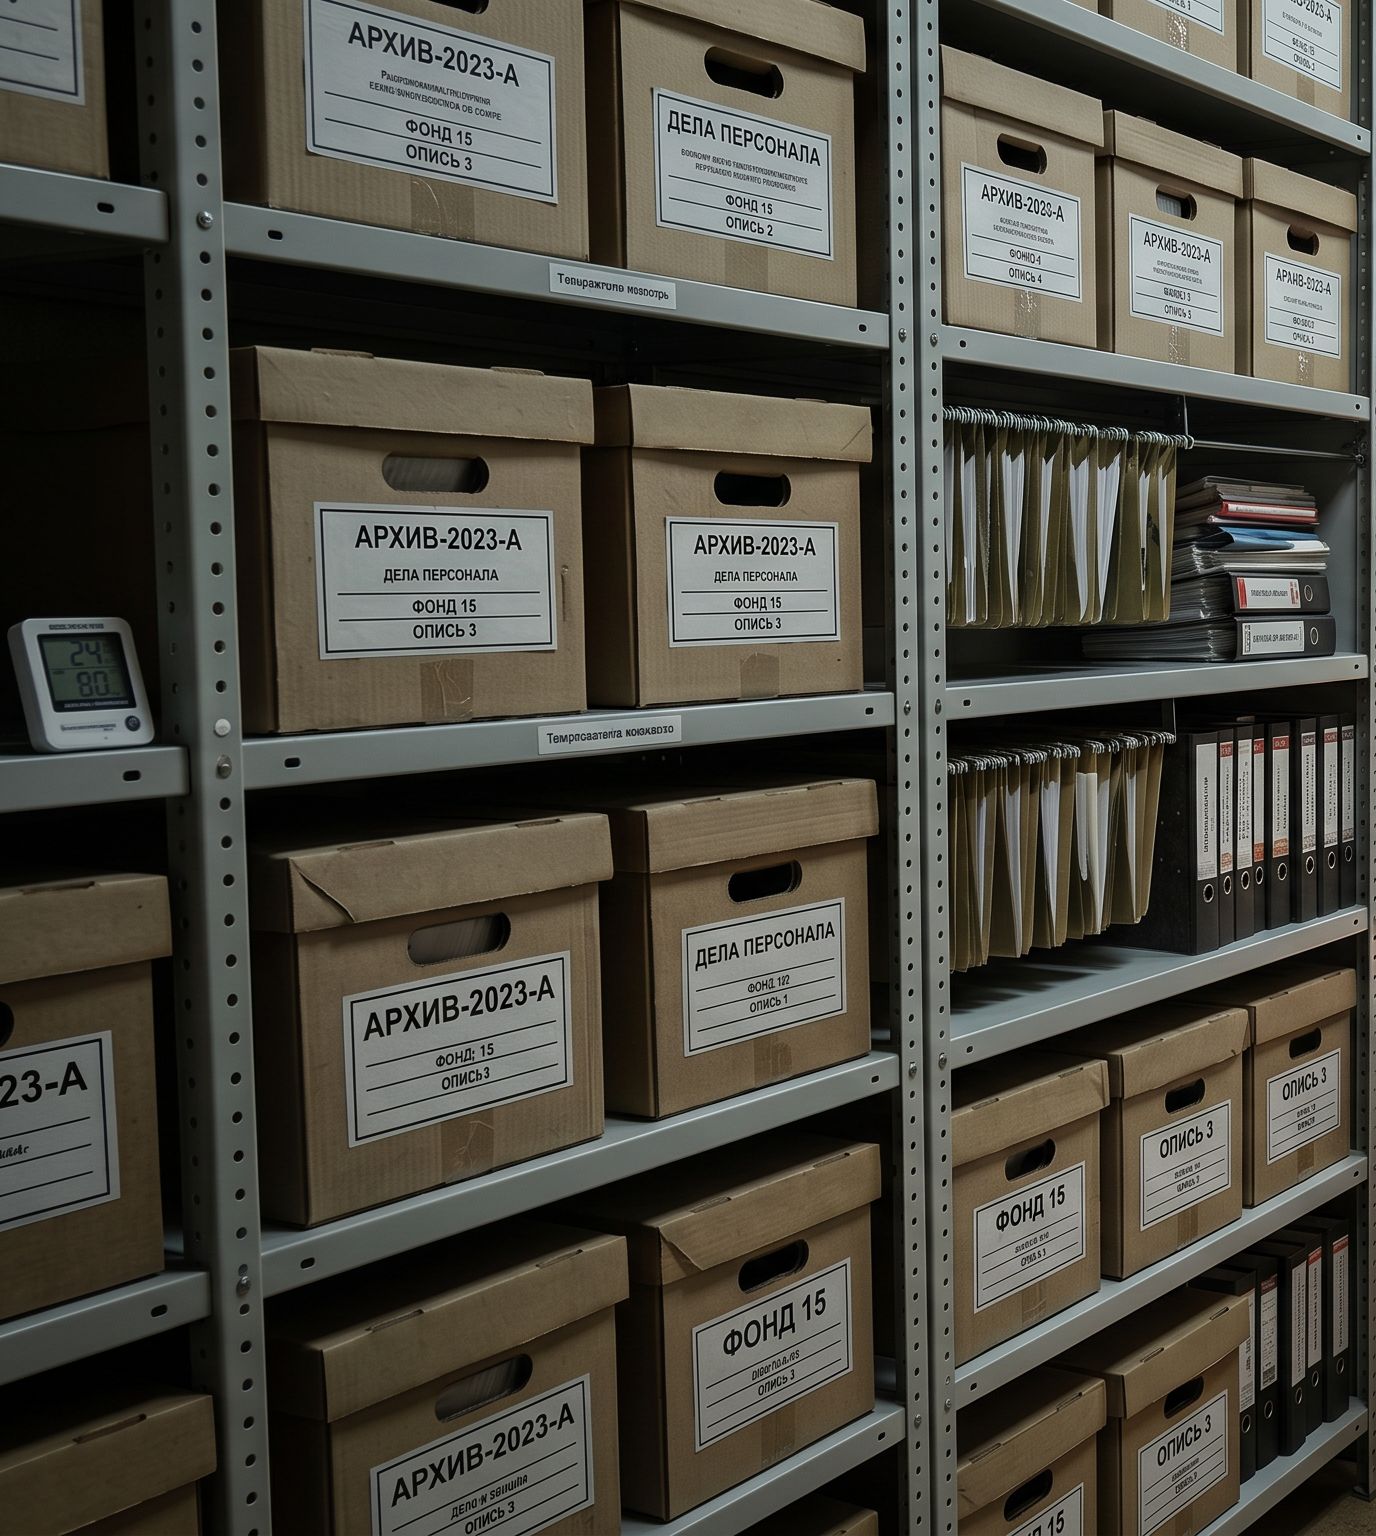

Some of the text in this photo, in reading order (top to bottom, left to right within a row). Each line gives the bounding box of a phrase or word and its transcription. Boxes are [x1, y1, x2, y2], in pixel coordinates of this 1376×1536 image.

[348, 21, 519, 87] АРХИВ-2023-А
[405, 119, 473, 146] ФОНД 15
[667, 110, 821, 167] ДЕЛА ПЕРСОНАЛА
[405, 144, 473, 171] ОПИСЬ 3
[725, 194, 758, 213] ФОНД
[725, 216, 774, 237] ОПИСЬ 2
[355, 525, 522, 550] АРХИВ-2023-А
[693, 534, 816, 556] АРХИВ-2023-А
[383, 569, 499, 583] ДЕЛА ПЕРСОНАЛА
[412, 599, 477, 615] ФОНД 15
[733, 596, 782, 611] ФОНД 15
[412, 623, 477, 639] ОПИСЬ 3
[734, 617, 782, 631] ОПИСЬ 3
[70, 640, 103, 667] 24
[77, 671, 110, 698] 80
[695, 921, 835, 972] ДЕЛА ПЕРСОНАЛА
[362, 975, 556, 1042] АРХИВ-2023-А
[749, 994, 789, 1013] ОПИСЬ 1
[480, 1043, 494, 1057] 15
[1282, 1066, 1327, 1101] ОПИСЬ 3
[1159, 1120, 1213, 1159] ОПИСЬ 3
[995, 1183, 1066, 1233] ФОНД 15
[722, 1287, 827, 1357] ФОНД 15
[790, 1369, 796, 1381] 3
[1156, 1414, 1212, 1467] ОПИСЬ 3
[390, 1402, 575, 1508] АРХИВ-2023-А
[464, 1501, 515, 1535] ОПИСЬ 3
